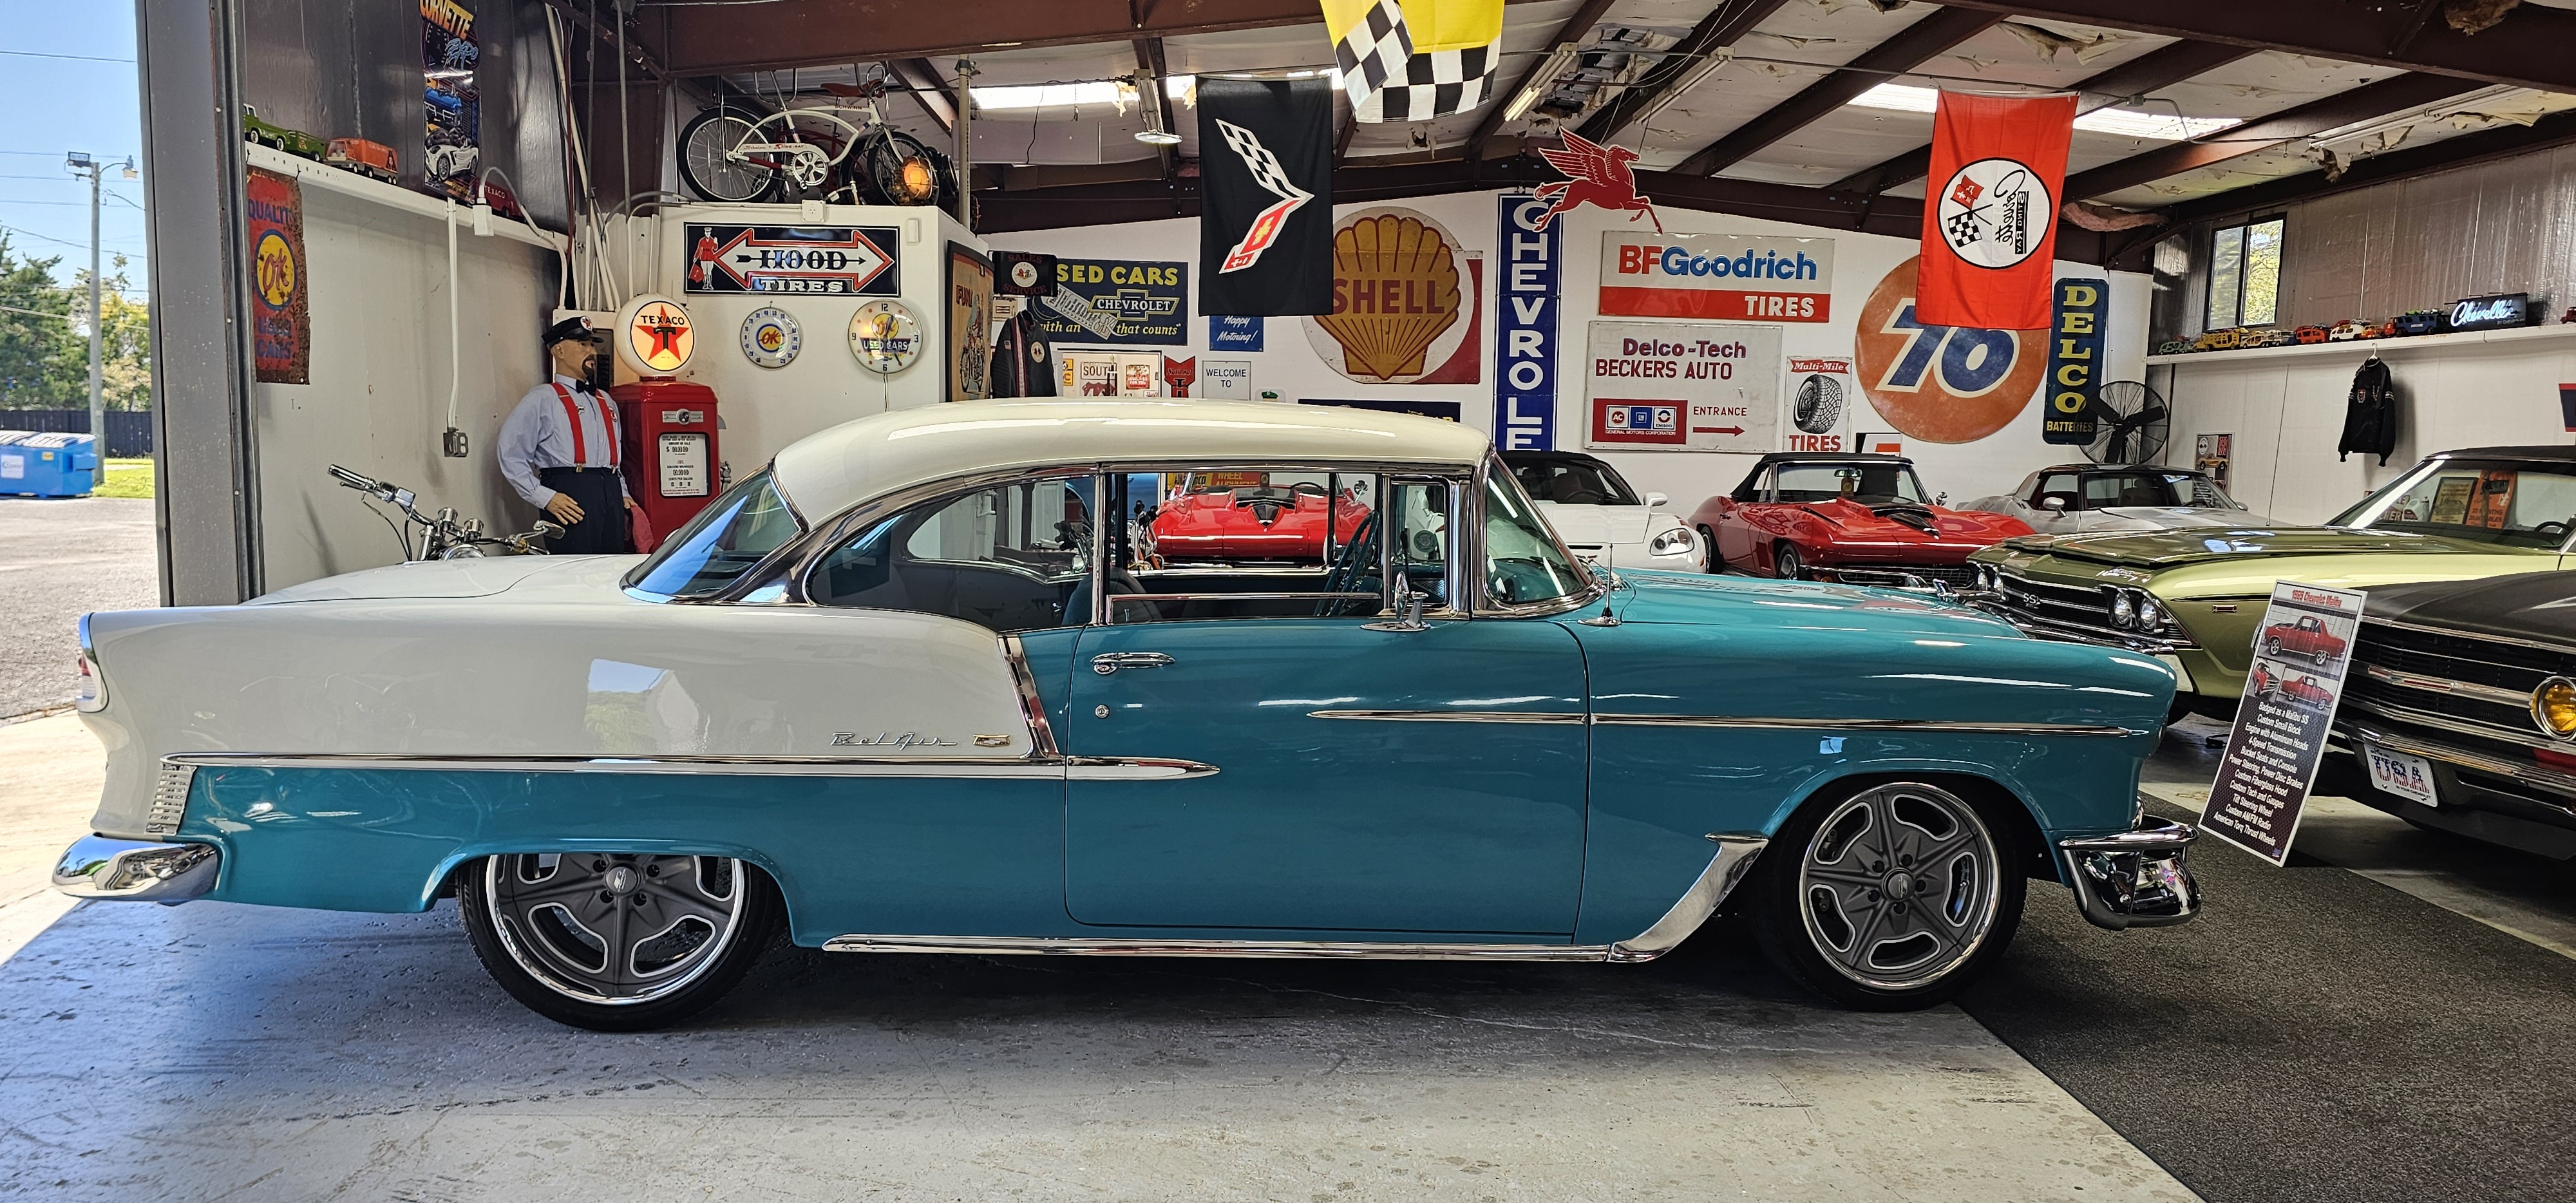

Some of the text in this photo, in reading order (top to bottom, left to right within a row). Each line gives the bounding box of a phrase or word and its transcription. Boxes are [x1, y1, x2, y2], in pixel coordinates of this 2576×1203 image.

[420, 0, 473, 39] CORVETTE
[484, 185, 506, 199] TEXACO
[248, 198, 294, 224] QUALIT
[262, 247, 290, 291] OK
[759, 249, 848, 270] HOOD
[1008, 253, 1043, 264] SALES
[1618, 245, 1817, 280] BFGoodrich
[761, 279, 844, 293] TIRES
[1110, 266, 1179, 286] CARS
[956, 285, 973, 308] FUN!
[1003, 283, 1047, 295] SERVICE
[1333, 278, 1445, 314] SHELL
[881, 303, 889, 312] 12
[1097, 298, 1171, 312] CHEVROLET
[1745, 295, 1815, 317] TIRES
[640, 315, 685, 326] TEXACO
[1066, 323, 1081, 333] an
[1116, 323, 1140, 335] that
[1224, 315, 1251, 328] Happy
[653, 327, 676, 350] T
[760, 330, 781, 345] OK
[864, 340, 908, 350] USED CARS
[1217, 330, 1258, 345] Motoring!
[1875, 298, 2020, 399] 76
[2055, 286, 2098, 413] DELCO
[1206, 368, 1246, 377] WELCOME
[1596, 359, 1732, 380] BECKERS AUTO
[1794, 362, 1844, 371] Multi-Mile
[1693, 406, 1747, 417] ENTRANCE
[2047, 421, 2094, 433] BATTERIES
[1789, 435, 1841, 451] TIRES
[2023, 592, 2036, 604] SS
[2259, 701, 2276, 715] Badged
[2285, 709, 2302, 721] Malibu
[2300, 714, 2309, 725] SS
[2257, 714, 2302, 735] Custom Small Block
[2245, 722, 2309, 751] Engine with Aluminum Heads
[2248, 736, 2297, 760] 4-Speed Transmission
[2240, 746, 2298, 773] Bucket Seats and Console
[2228, 753, 2242, 766] Power
[2260, 766, 2276, 779] Power
[2275, 772, 2287, 782] Disc
[2286, 775, 2304, 790] Brakes
[2371, 755, 2429, 794] USA
[2235, 769, 2289, 797] Custom Fiberglass Hood
[2230, 780, 2285, 809] Custom Tach and Gauges
[2410, 790, 2431, 799] CHEVROLET
[2226, 803, 2271, 831] Custom AM/FM Radio
[2239, 797, 2259, 813] Steering
[2258, 804, 2274, 817] Wheel
[2213, 811, 2277, 846] American Torq Thrust Wheels
